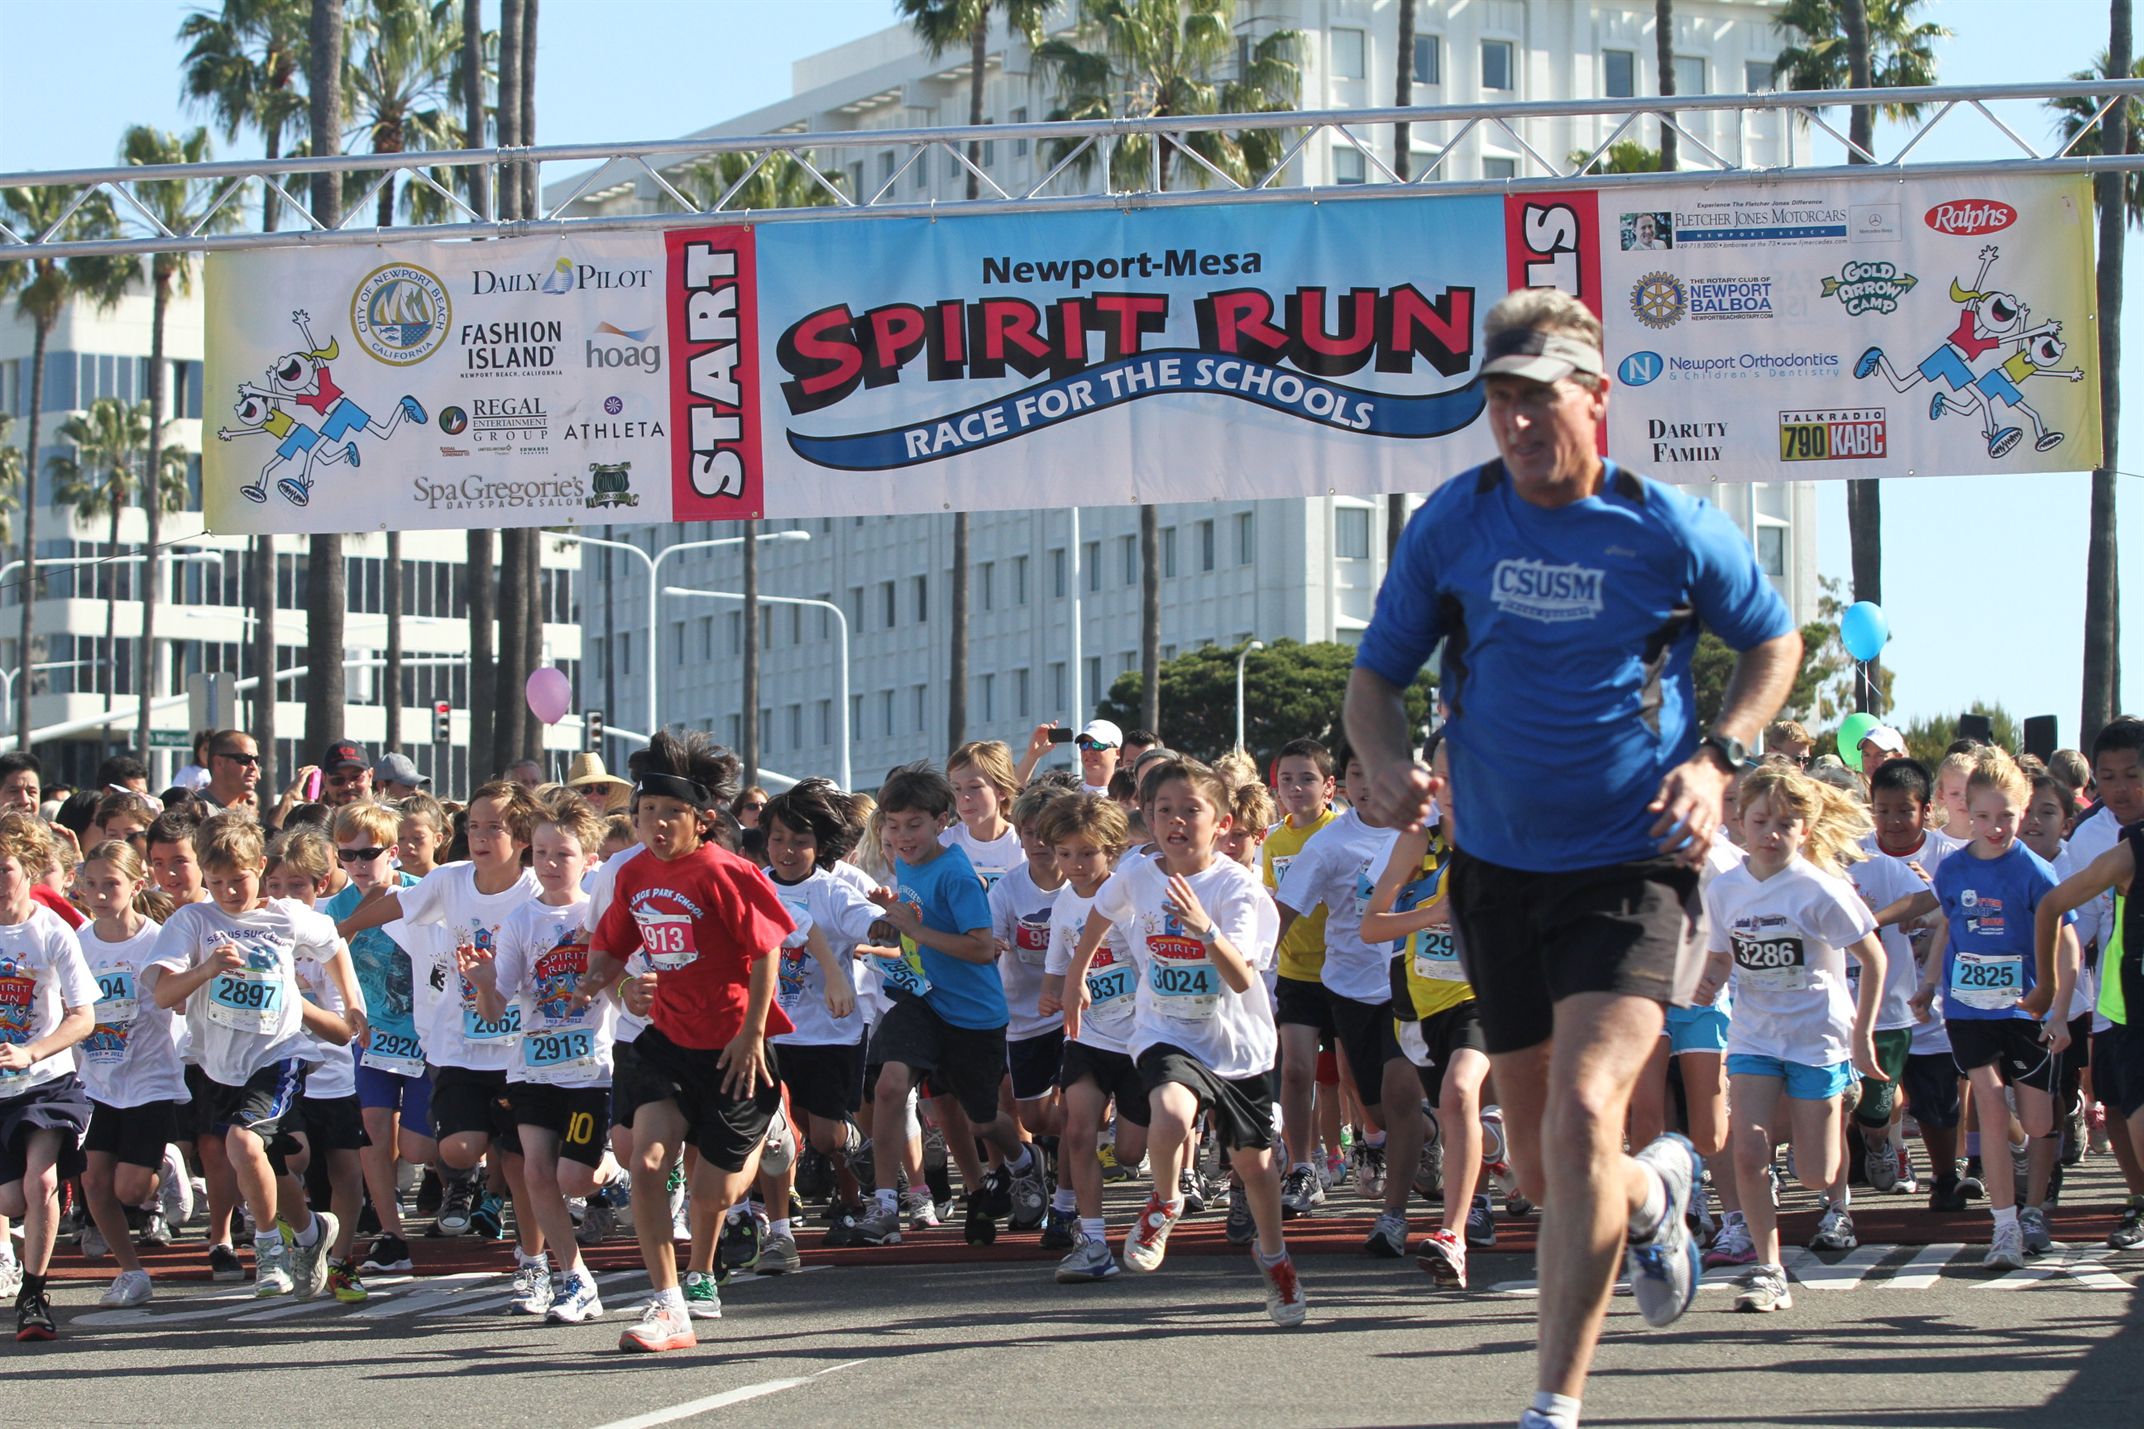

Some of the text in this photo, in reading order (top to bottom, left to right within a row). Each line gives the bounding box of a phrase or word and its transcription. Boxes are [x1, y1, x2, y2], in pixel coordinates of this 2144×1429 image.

[1675, 208, 1847, 228] FLETCHER JONES MOTORCARS
[1934, 202, 2007, 233] Ralphs
[472, 264, 652, 295] DAILY PILOT
[982, 249, 1262, 289] Newport-Mesa
[1843, 262, 1896, 283] GOLD
[357, 269, 446, 333] CITY OF NEWPORT BEACH
[1690, 283, 1772, 299] NEWPORT
[1838, 280, 1902, 301] ARROW
[1690, 298, 1772, 313] BALBOA
[1847, 298, 1897, 315] CAMP
[1690, 313, 1774, 321] NEWPORTBEACHROTARY.COM
[461, 320, 562, 345] FASHION
[371, 342, 433, 360] CALIFORNIA
[468, 346, 555, 370] ISLAND
[586, 339, 661, 374] hoag
[776, 282, 1475, 416] SPIRIT RUN
[684, 241, 746, 499] START
[1669, 352, 1839, 374] Newport Orthodontics
[1684, 369, 1760, 380] Children's
[1769, 367, 1840, 378] Dentistry
[460, 371, 493, 379] NEWPORT
[473, 398, 548, 416] REGAL
[904, 358, 1374, 460] RACE FOR THE SCHOOLS
[1782, 411, 1882, 423] TALKRADIO
[473, 418, 548, 428] ENTERTAINMENT
[564, 421, 665, 440] ATHLETA
[1648, 419, 1729, 439] DARUTY
[473, 431, 548, 442] GROUP
[1784, 423, 1884, 458] 790 KABC
[1652, 443, 1723, 463] FAMILY
[413, 473, 584, 509] Spa Gregorie's
[446, 501, 472, 509] DAY
[479, 500, 505, 509] SPA
[539, 498, 583, 507] SALON
[1500, 566, 1596, 601] CSUSM
[652, 887, 673, 899] PARK
[675, 892, 704, 920] SCHOOL
[228, 930, 241, 940] US
[641, 924, 685, 952] 913
[1424, 933, 1456, 957] 29
[541, 951, 588, 967] SPIRIT
[1150, 941, 1200, 957] SPIRIT
[1738, 941, 1796, 967] 3286
[548, 962, 577, 975] RUN
[1153, 964, 1209, 993] 3024
[1960, 963, 2014, 987] 2825
[0, 984, 30, 993] IRIT
[99, 977, 127, 1000] 04
[218, 977, 276, 1009] 2897
[1087, 973, 1125, 1000] 837
[0, 994, 20, 1003] UN
[373, 1033, 422, 1059] 2920
[532, 1034, 589, 1061] 2913
[566, 1111, 594, 1144] 10
